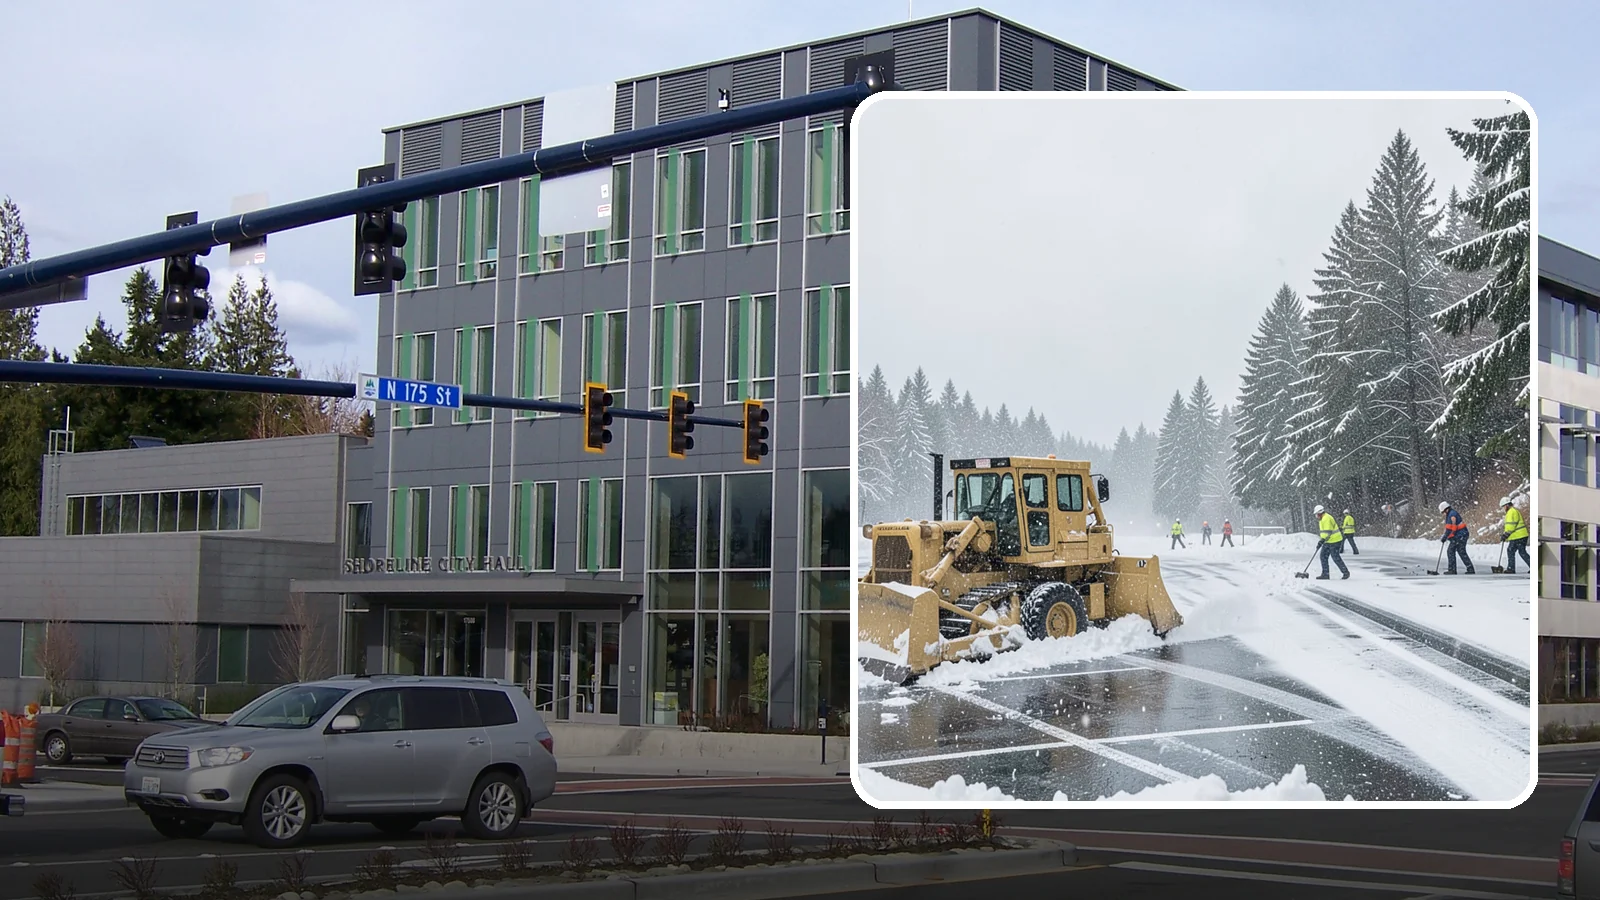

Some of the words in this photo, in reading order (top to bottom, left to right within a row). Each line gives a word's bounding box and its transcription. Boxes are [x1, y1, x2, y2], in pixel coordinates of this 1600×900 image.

[387, 380, 396, 400] N
[405, 382, 428, 403] 175
[436, 386, 451, 406] St
[344, 557, 432, 574] SHORELINE
[438, 556, 475, 573] CITY
[484, 555, 526, 572] HALL
